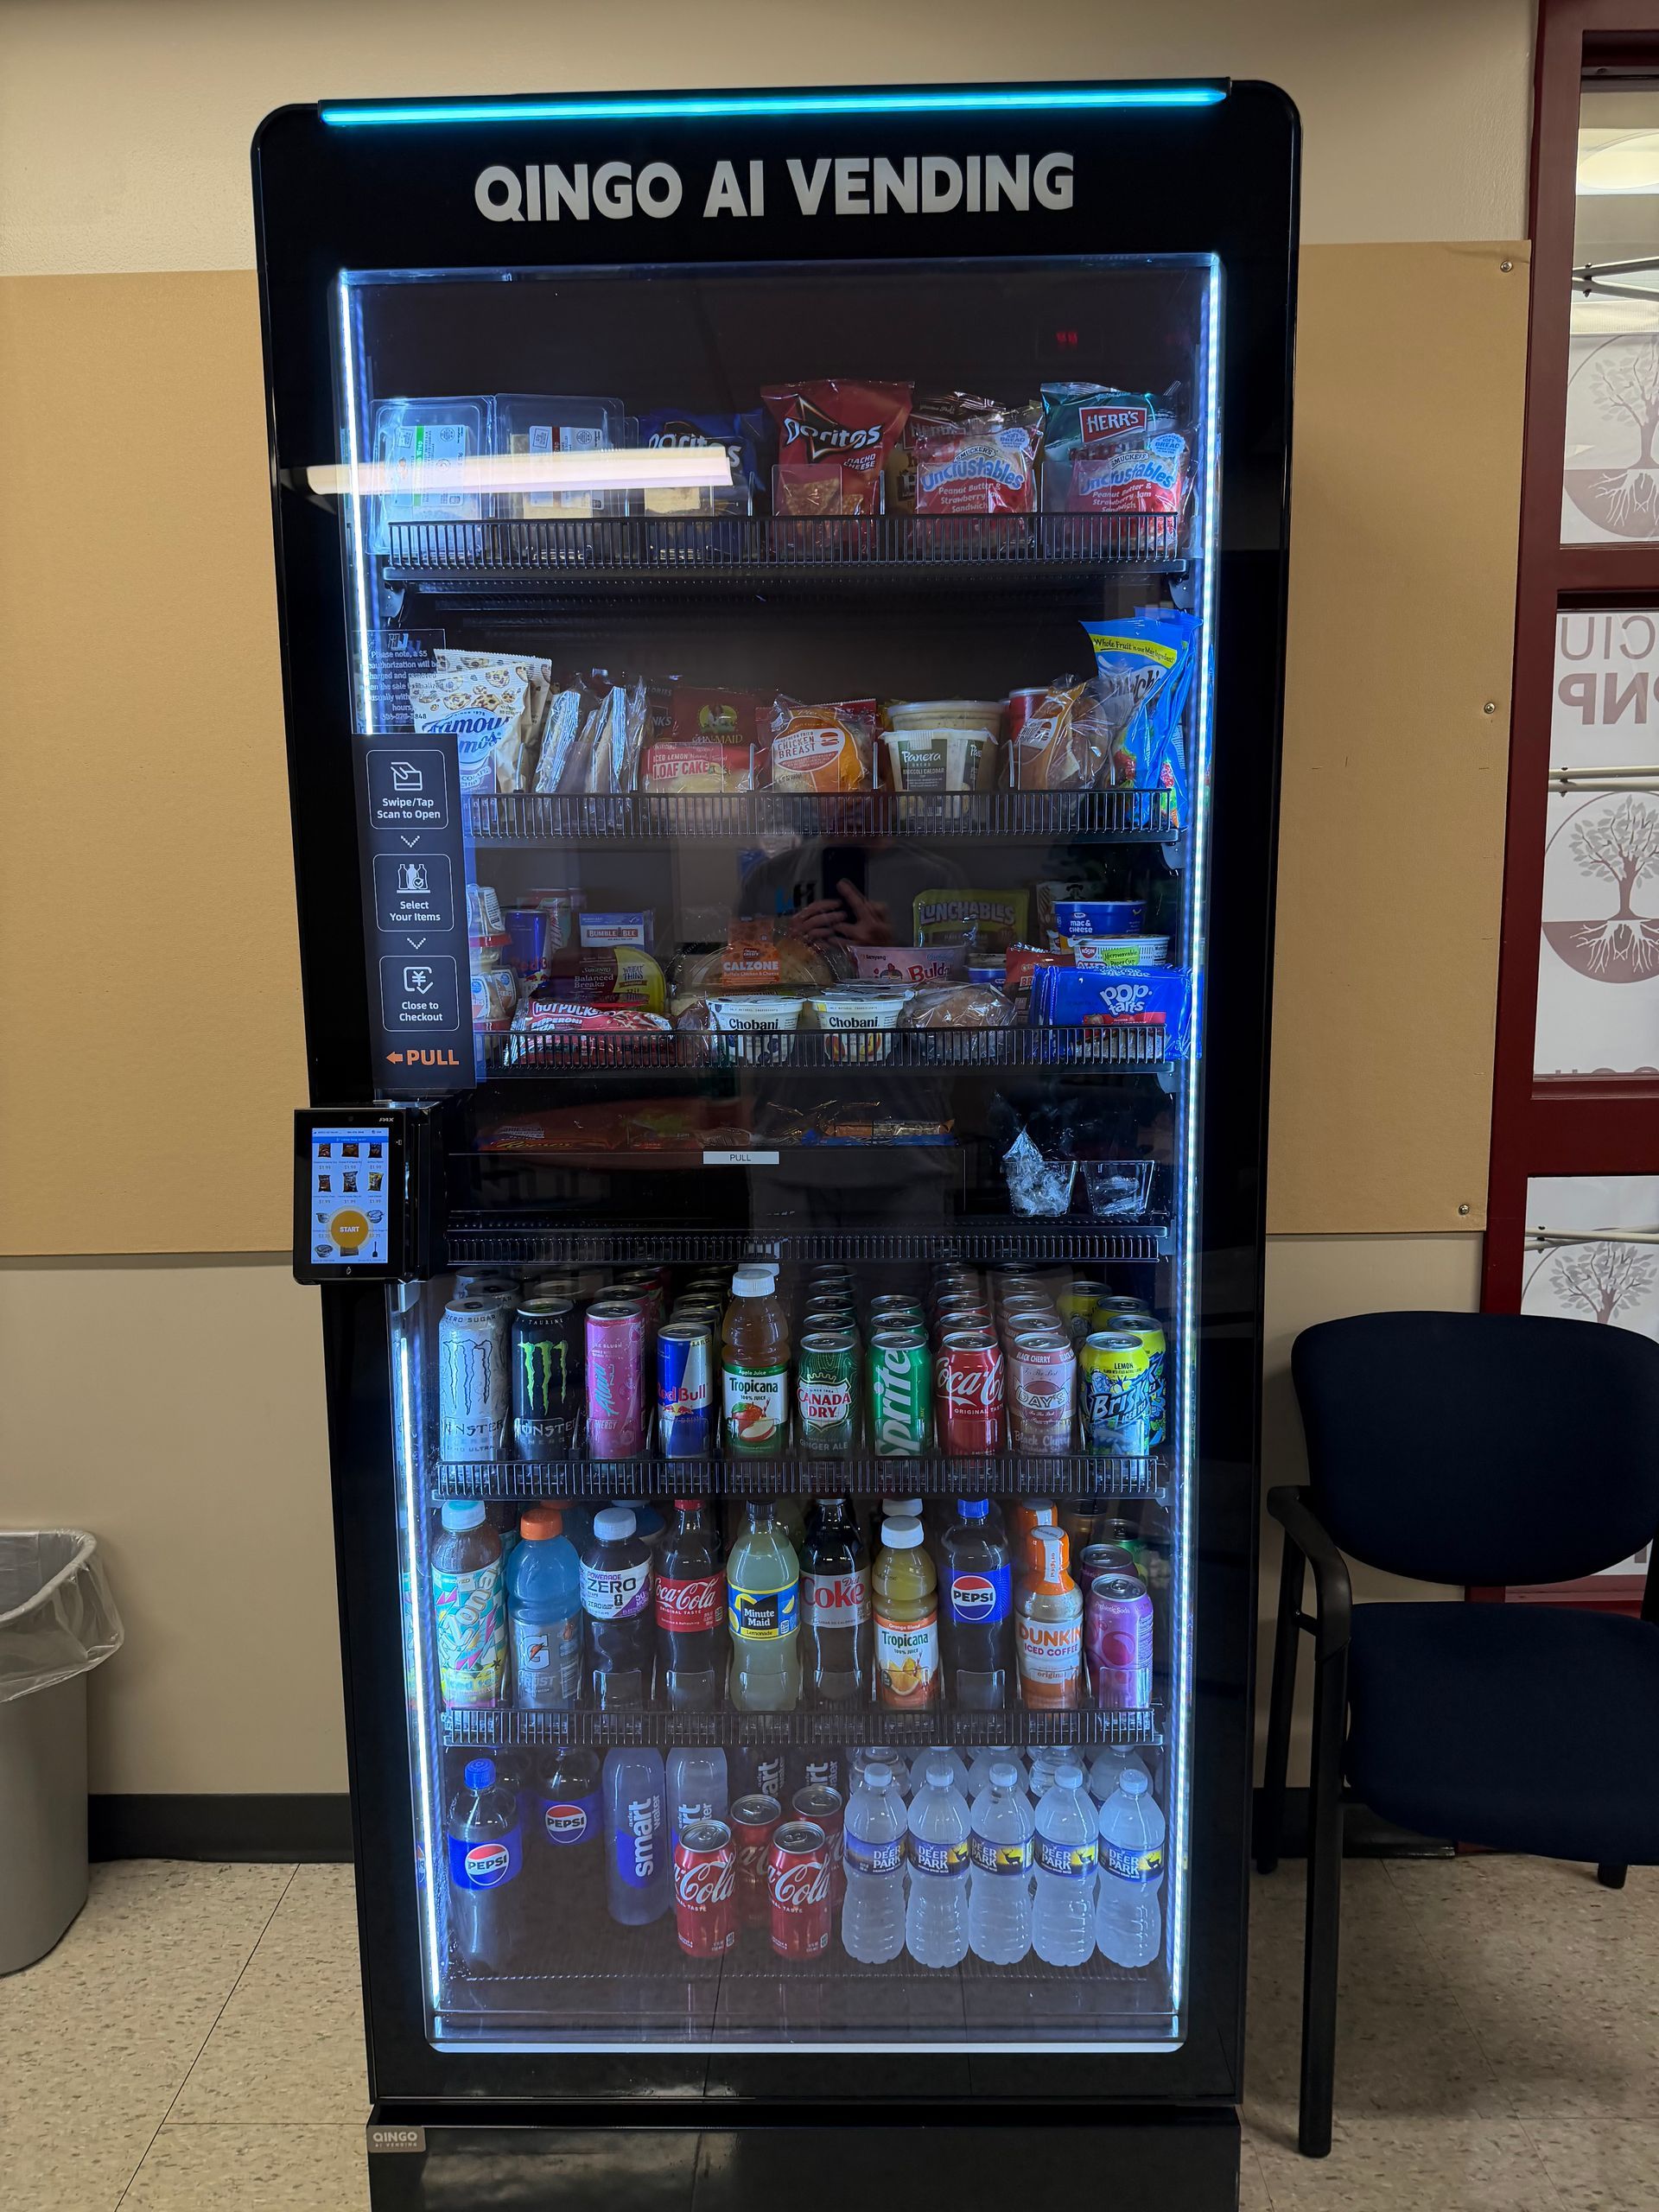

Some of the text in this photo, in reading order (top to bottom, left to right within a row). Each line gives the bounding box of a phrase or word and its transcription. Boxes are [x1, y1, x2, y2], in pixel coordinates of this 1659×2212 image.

[474, 153, 1074, 224] QINGO AI VENDING
[1087, 410, 1140, 434] HERR'S
[784, 416, 883, 450] Doritos
[843, 461, 876, 471] CHEESE
[846, 454, 876, 465] NACHO
[921, 457, 1026, 492] Uncrustables
[938, 486, 966, 495] Peanut
[968, 484, 993, 493] Butter
[941, 493, 986, 505] Strawberry
[951, 502, 988, 513] Sandwich
[1094, 639, 1132, 650] Whole Fruit
[778, 736, 815, 752] CHICKEN
[779, 743, 816, 759] BREAST
[901, 750, 942, 763] Panera
[653, 761, 709, 779] LOAF CAKE
[382, 798, 435, 808] Swipe/Tap
[377, 810, 441, 820] Scan to Open
[400, 900, 429, 910] Select
[390, 912, 441, 921] Your Items
[920, 901, 1016, 926] LUNCHABLES
[723, 961, 779, 971] CALZONE
[574, 974, 614, 982] Balanced
[401, 1001, 439, 1010] Close to
[1108, 1000, 1145, 1015] tarts
[399, 1013, 443, 1021] Checkout
[531, 1017, 583, 1028] PEPPERONI
[829, 1016, 879, 1027] Chobani
[728, 1018, 779, 1030] Chobani
[407, 1049, 460, 1065] PULL
[729, 1154, 752, 1162] PULL
[445, 1313, 497, 1323] ZERO SUGAR
[1016, 1351, 1030, 1363] BLACK
[1030, 1354, 1051, 1363] CHERRY
[728, 1376, 779, 1395] Tropicana
[678, 1383, 706, 1402] Bull
[797, 1388, 852, 1406] CANADA
[1018, 1392, 1065, 1408] DAY'S
[809, 1407, 837, 1418] DRY
[799, 1438, 849, 1451] GINGER ALE
[587, 1577, 636, 1594] ZERO
[842, 1576, 861, 1587] Diet
[654, 1576, 720, 1611] Coca-Cola
[801, 1575, 865, 1609] Coke
[953, 1589, 994, 1604] PEPSI
[588, 1600, 601, 1610] ZERO
[743, 1608, 775, 1618] Minute
[747, 1617, 771, 1627] Maid
[881, 1630, 929, 1649] Tropicana
[522, 1634, 550, 1670] G
[1024, 1643, 1078, 1656] ICED COFFEE
[652, 1795, 661, 1831] water
[547, 1817, 585, 1828] PEPSI
[628, 1797, 654, 1878] smart
[874, 1845, 901, 1859] DEER
[918, 1846, 948, 1859] DEER
[972, 1838, 996, 1857] DEER
[1042, 1843, 1071, 1861] DEER
[467, 1855, 508, 1870] PEPSI
[873, 1856, 900, 1869] PARK
[971, 1849, 997, 1868] PARK
[1041, 1853, 1072, 1870] PARK
[1109, 1847, 1139, 1865] DEER
[918, 1858, 949, 1870] PARK
[1109, 1859, 1140, 1875] PARK
[372, 2132, 418, 2143] QINGO
